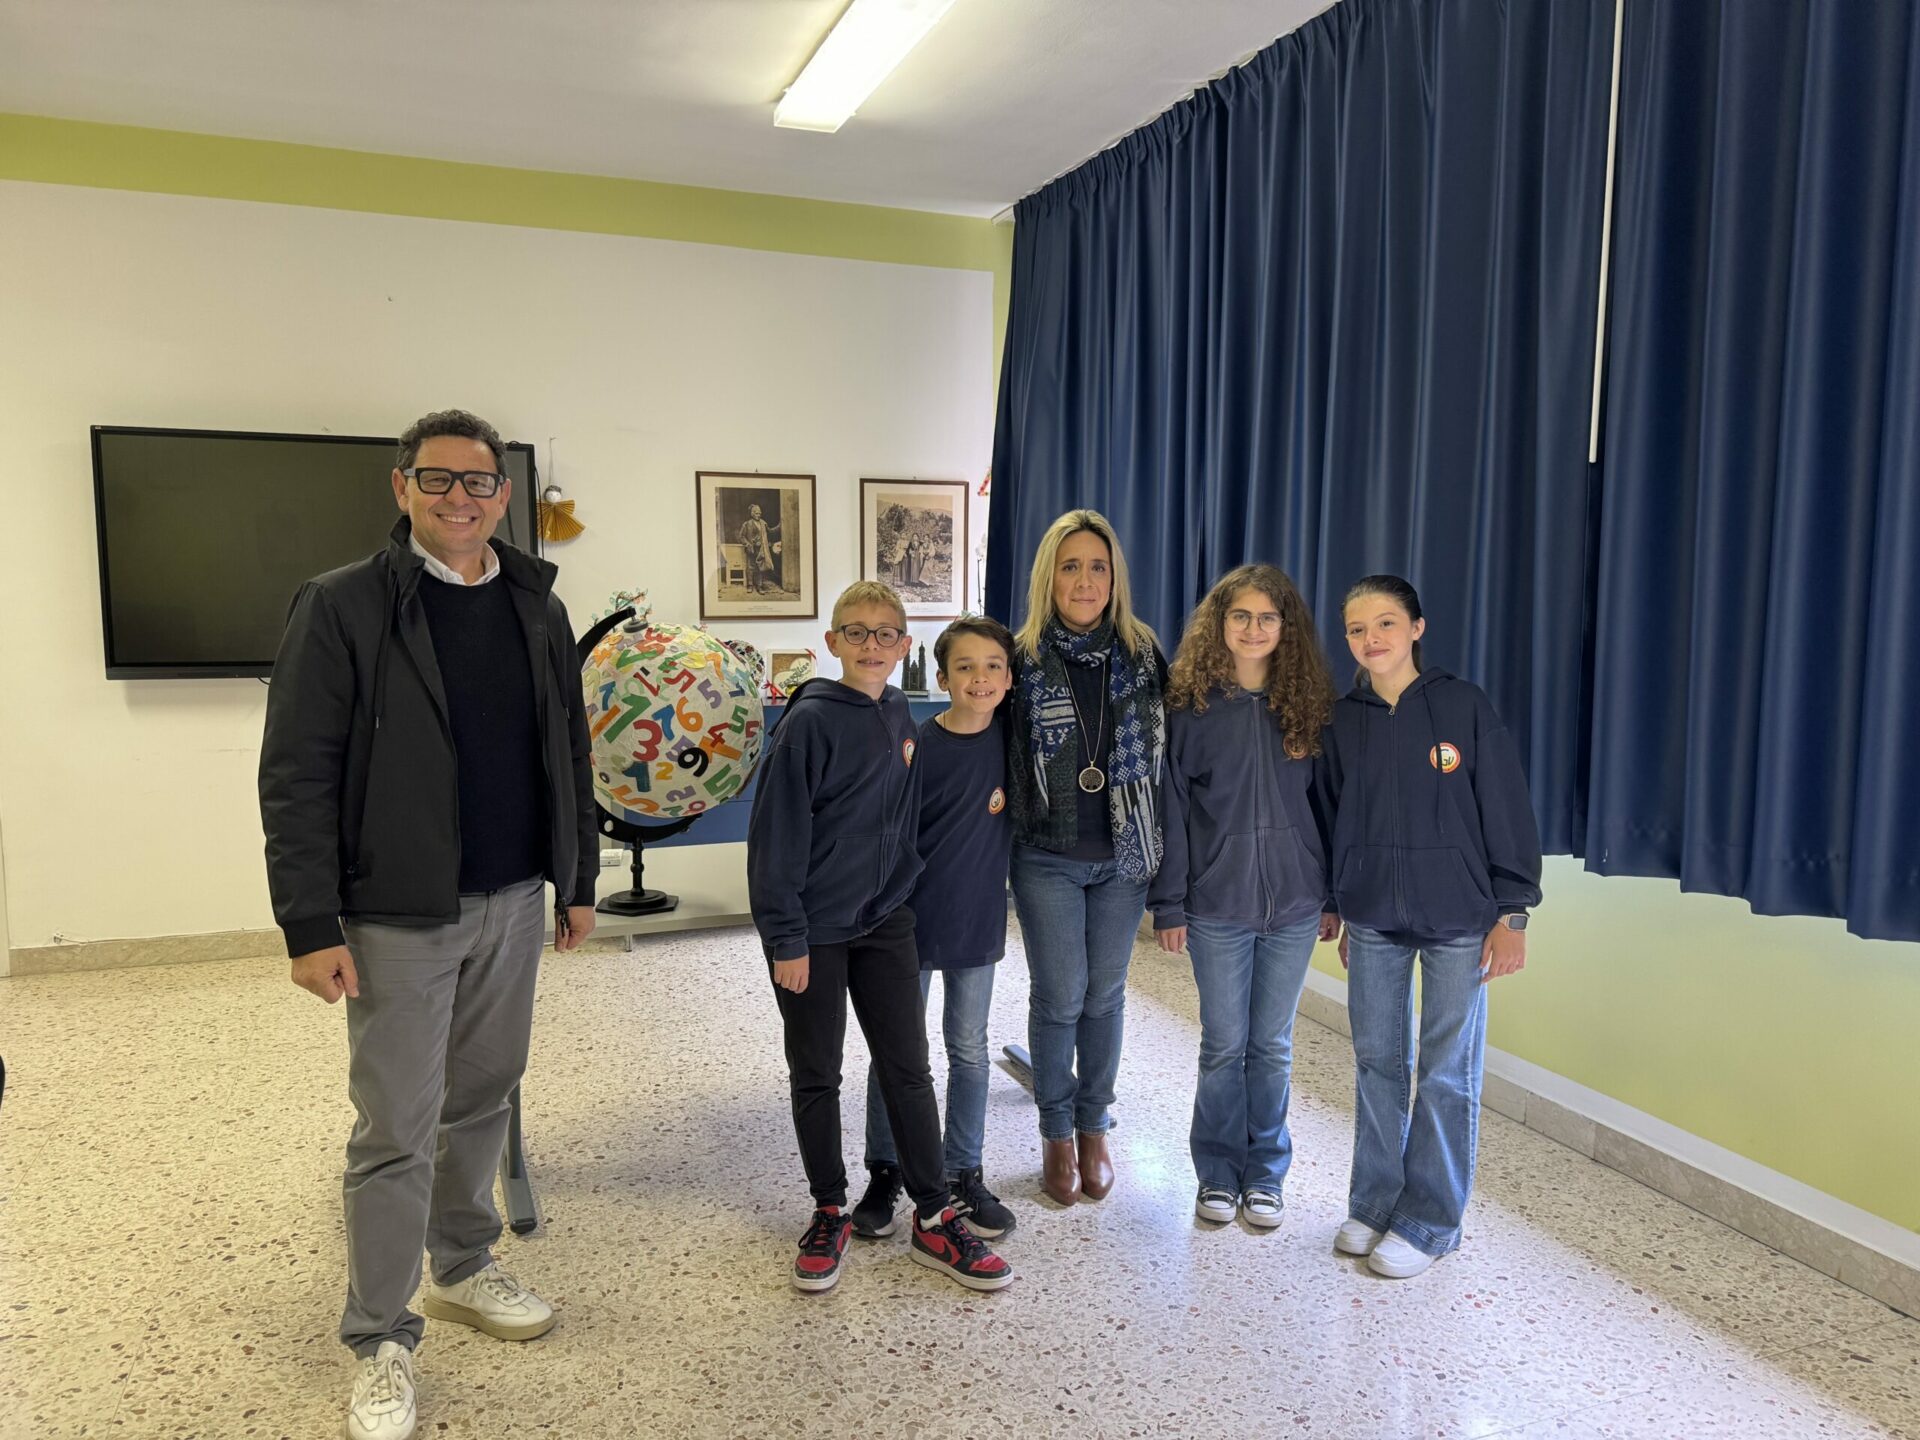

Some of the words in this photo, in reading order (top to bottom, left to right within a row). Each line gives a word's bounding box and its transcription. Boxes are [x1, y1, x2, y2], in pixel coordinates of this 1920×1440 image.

[697, 678, 721, 709] 5
[676, 696, 703, 732] 6
[729, 704, 748, 734] 5
[632, 719, 662, 762] 3
[655, 762, 675, 780] 2
[678, 747, 709, 777] 9
